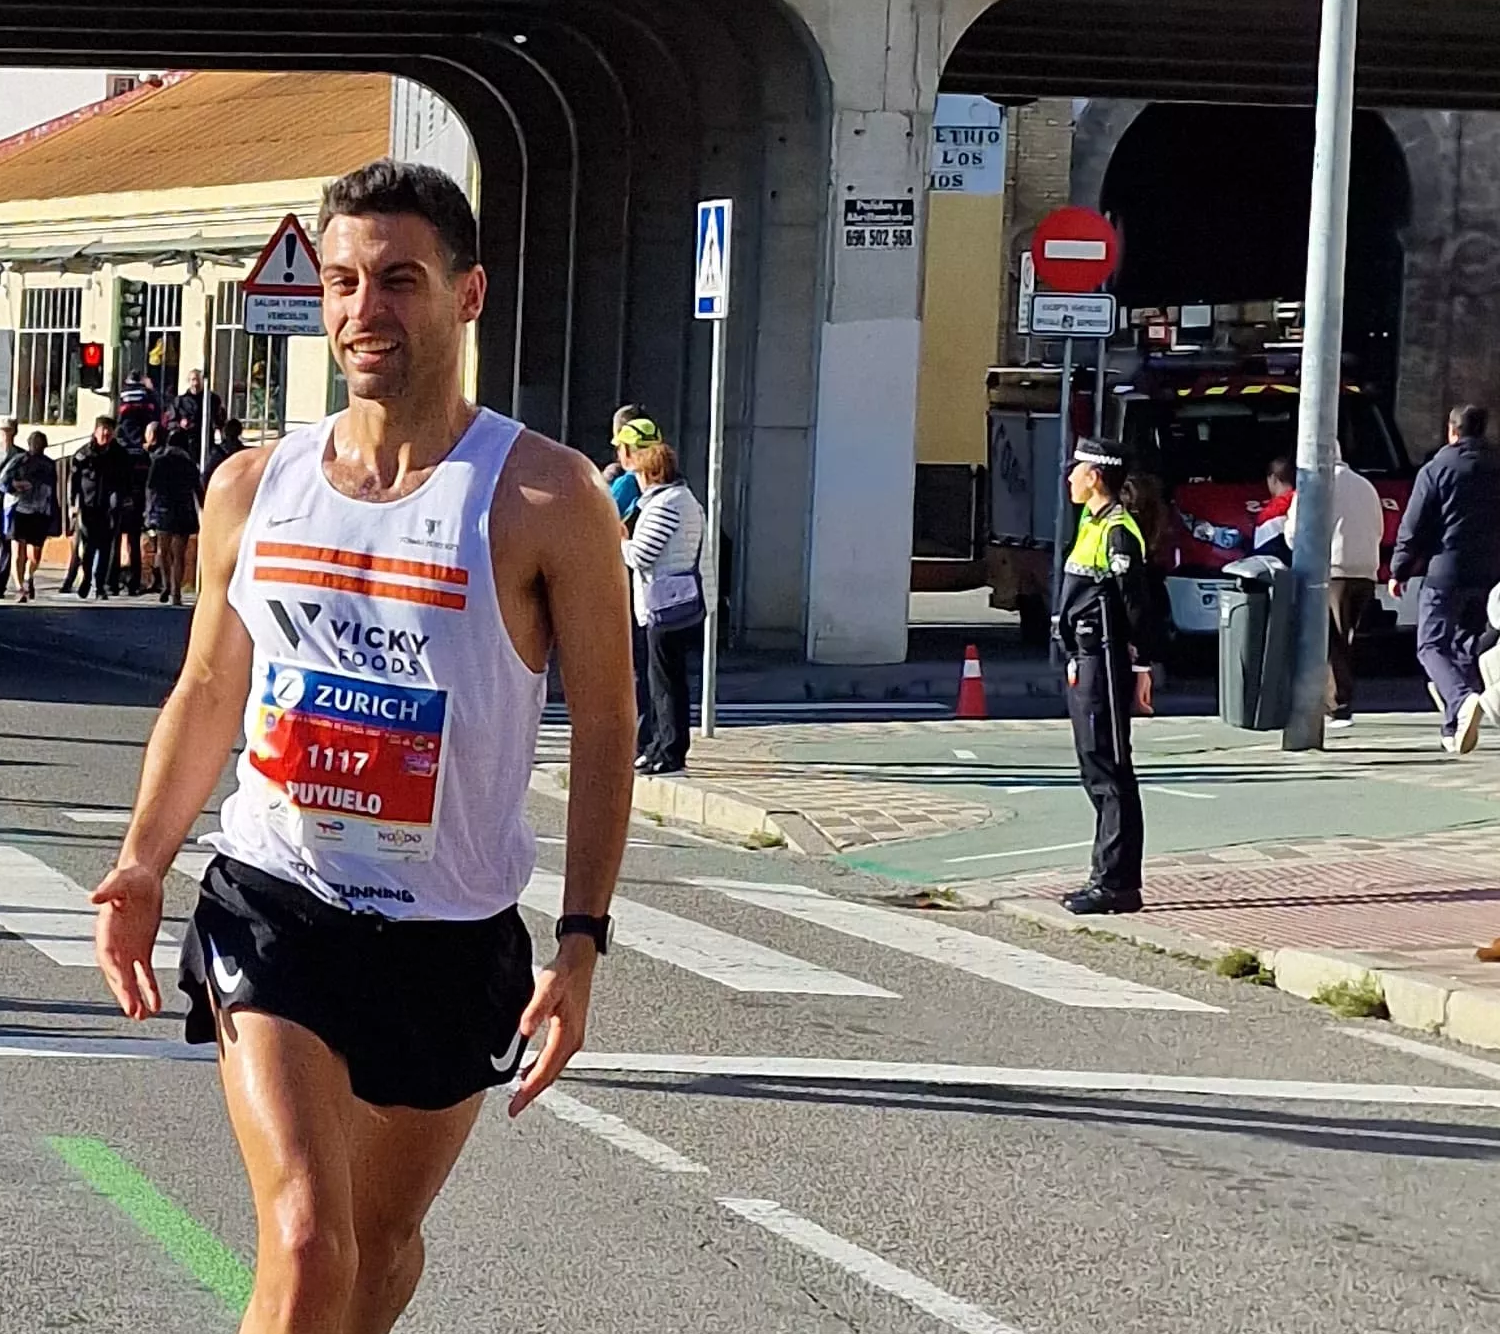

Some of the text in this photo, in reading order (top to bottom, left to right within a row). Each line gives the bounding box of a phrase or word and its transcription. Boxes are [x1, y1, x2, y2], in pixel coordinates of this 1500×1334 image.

[942, 150, 983, 166] LOS
[869, 229, 890, 247] 502
[330, 619, 430, 655] VICKY
[338, 648, 418, 676] FOODS
[314, 685, 419, 722] ZURICH
[308, 743, 370, 777] 1117
[286, 780, 382, 815] PUYUELO
